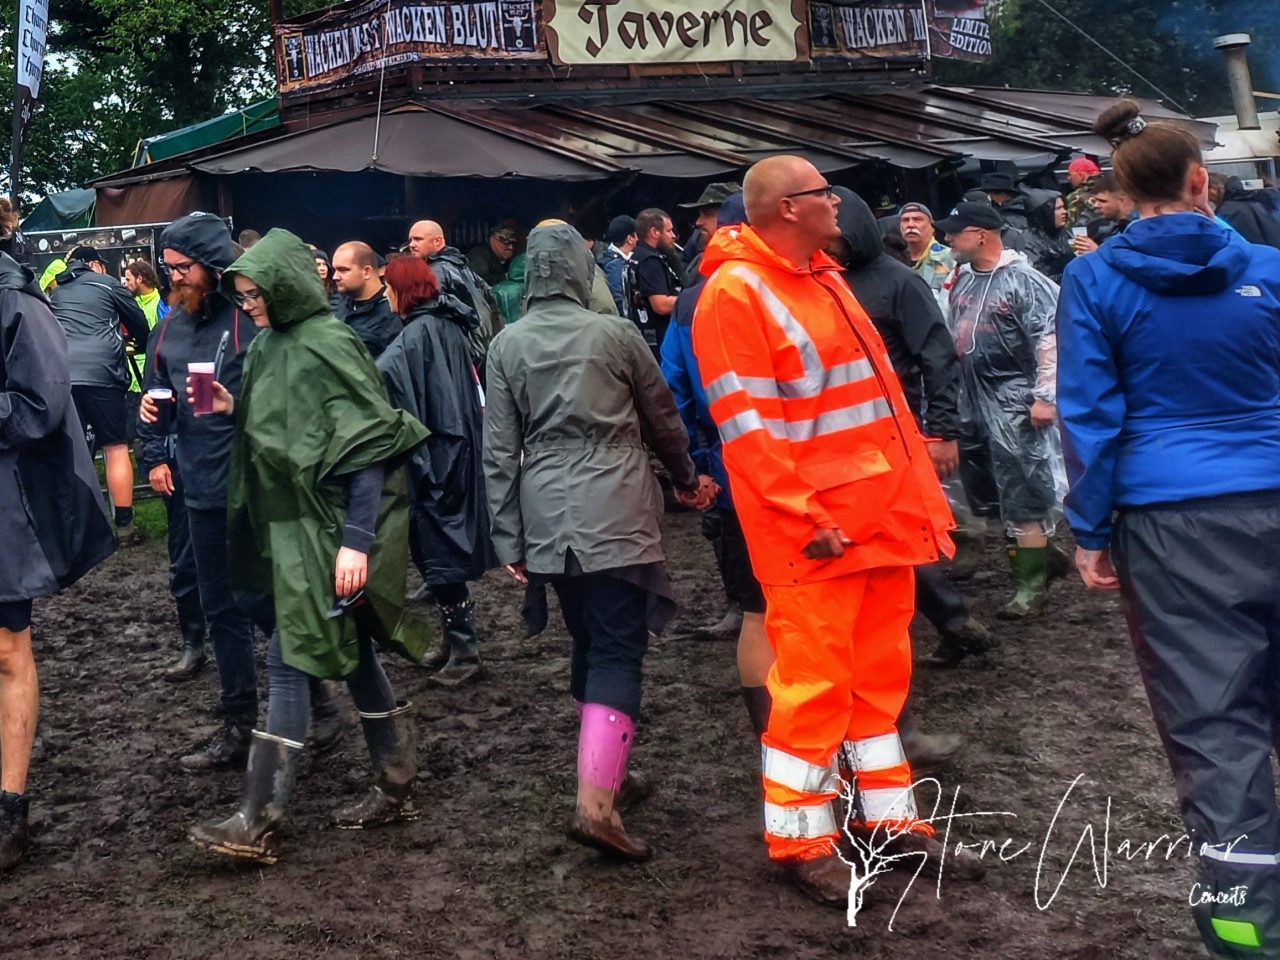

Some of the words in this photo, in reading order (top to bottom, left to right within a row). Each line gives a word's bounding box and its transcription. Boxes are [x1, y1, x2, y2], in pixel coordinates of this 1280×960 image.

[304, 29, 350, 78] WACKEN
[381, 6, 446, 44] WACKEN
[450, 1, 499, 49] BLUT
[839, 7, 907, 49] WACKEN
[951, 17, 991, 40] LIMITE
